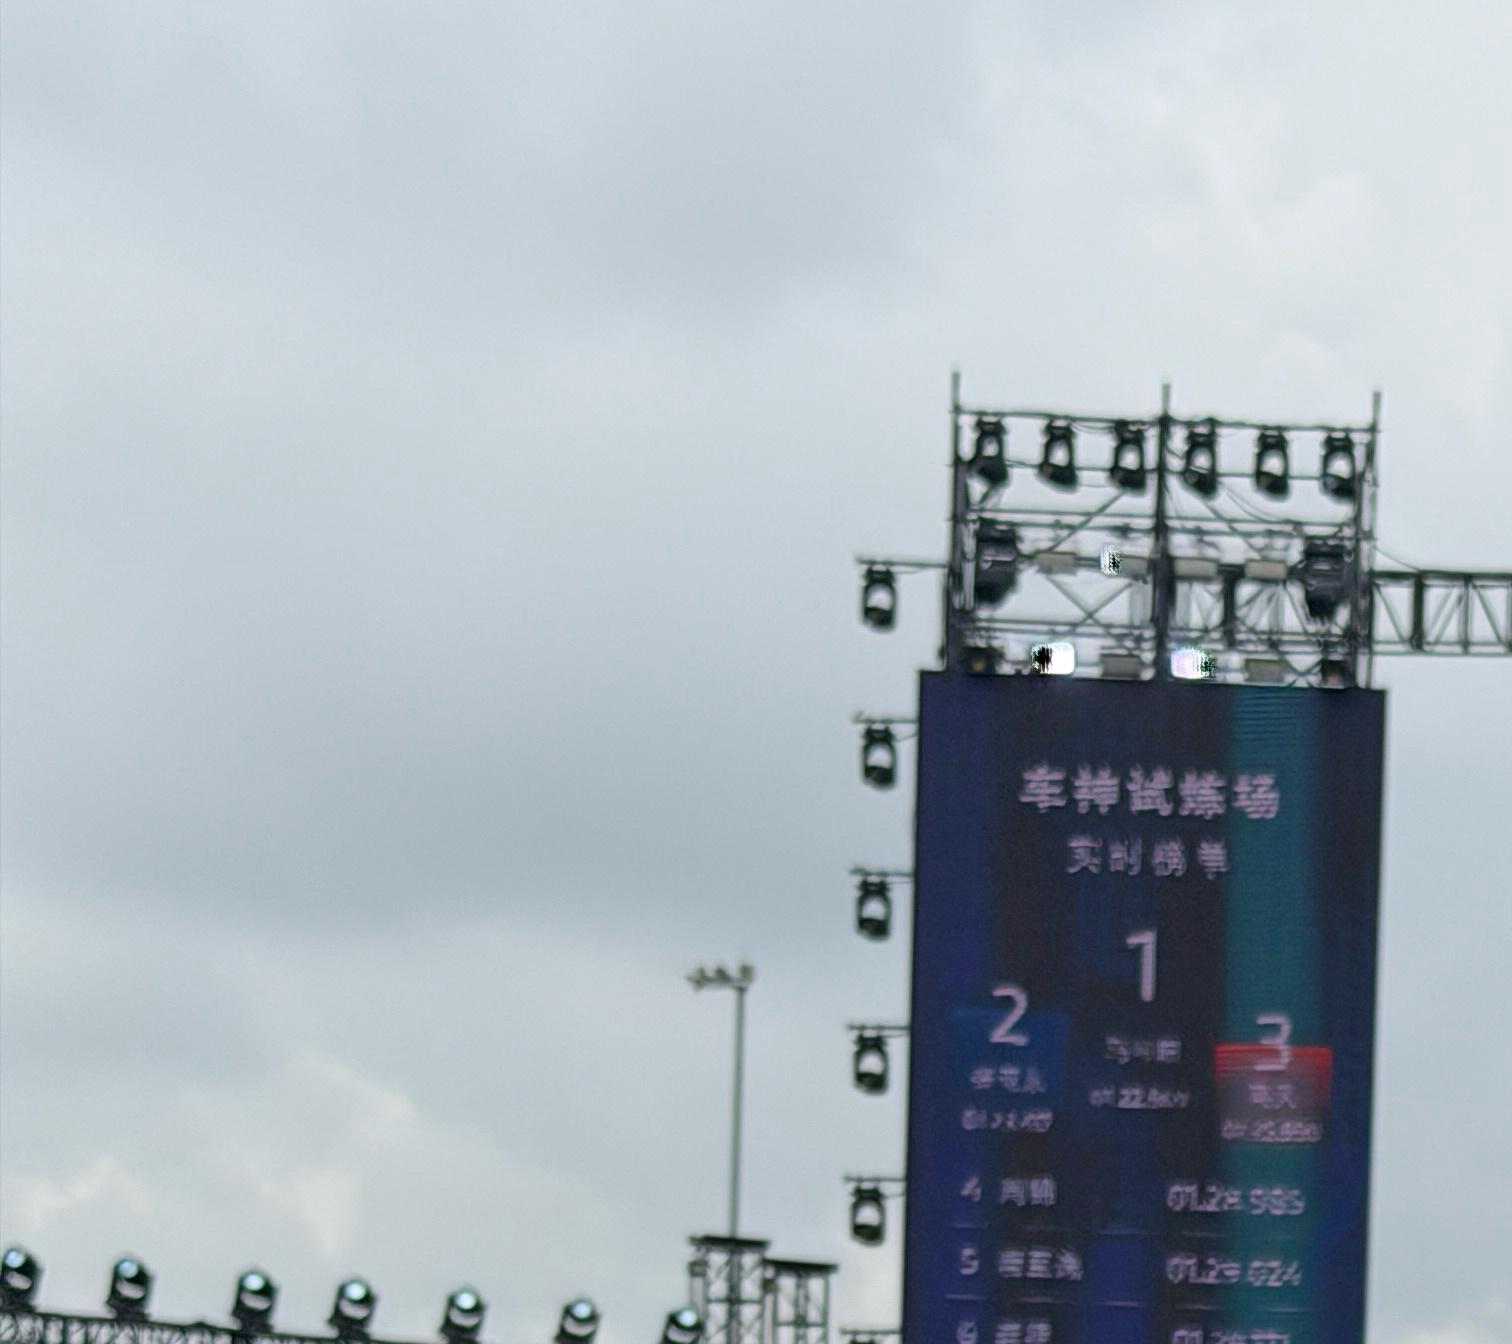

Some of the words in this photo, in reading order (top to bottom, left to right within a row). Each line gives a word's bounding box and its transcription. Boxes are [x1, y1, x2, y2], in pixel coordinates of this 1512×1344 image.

[1126, 929, 1157, 1002] 1
[990, 984, 1029, 1047] 2
[1255, 1013, 1293, 1072] 3
[960, 1176, 982, 1203] 4
[960, 1247, 980, 1276] 5
